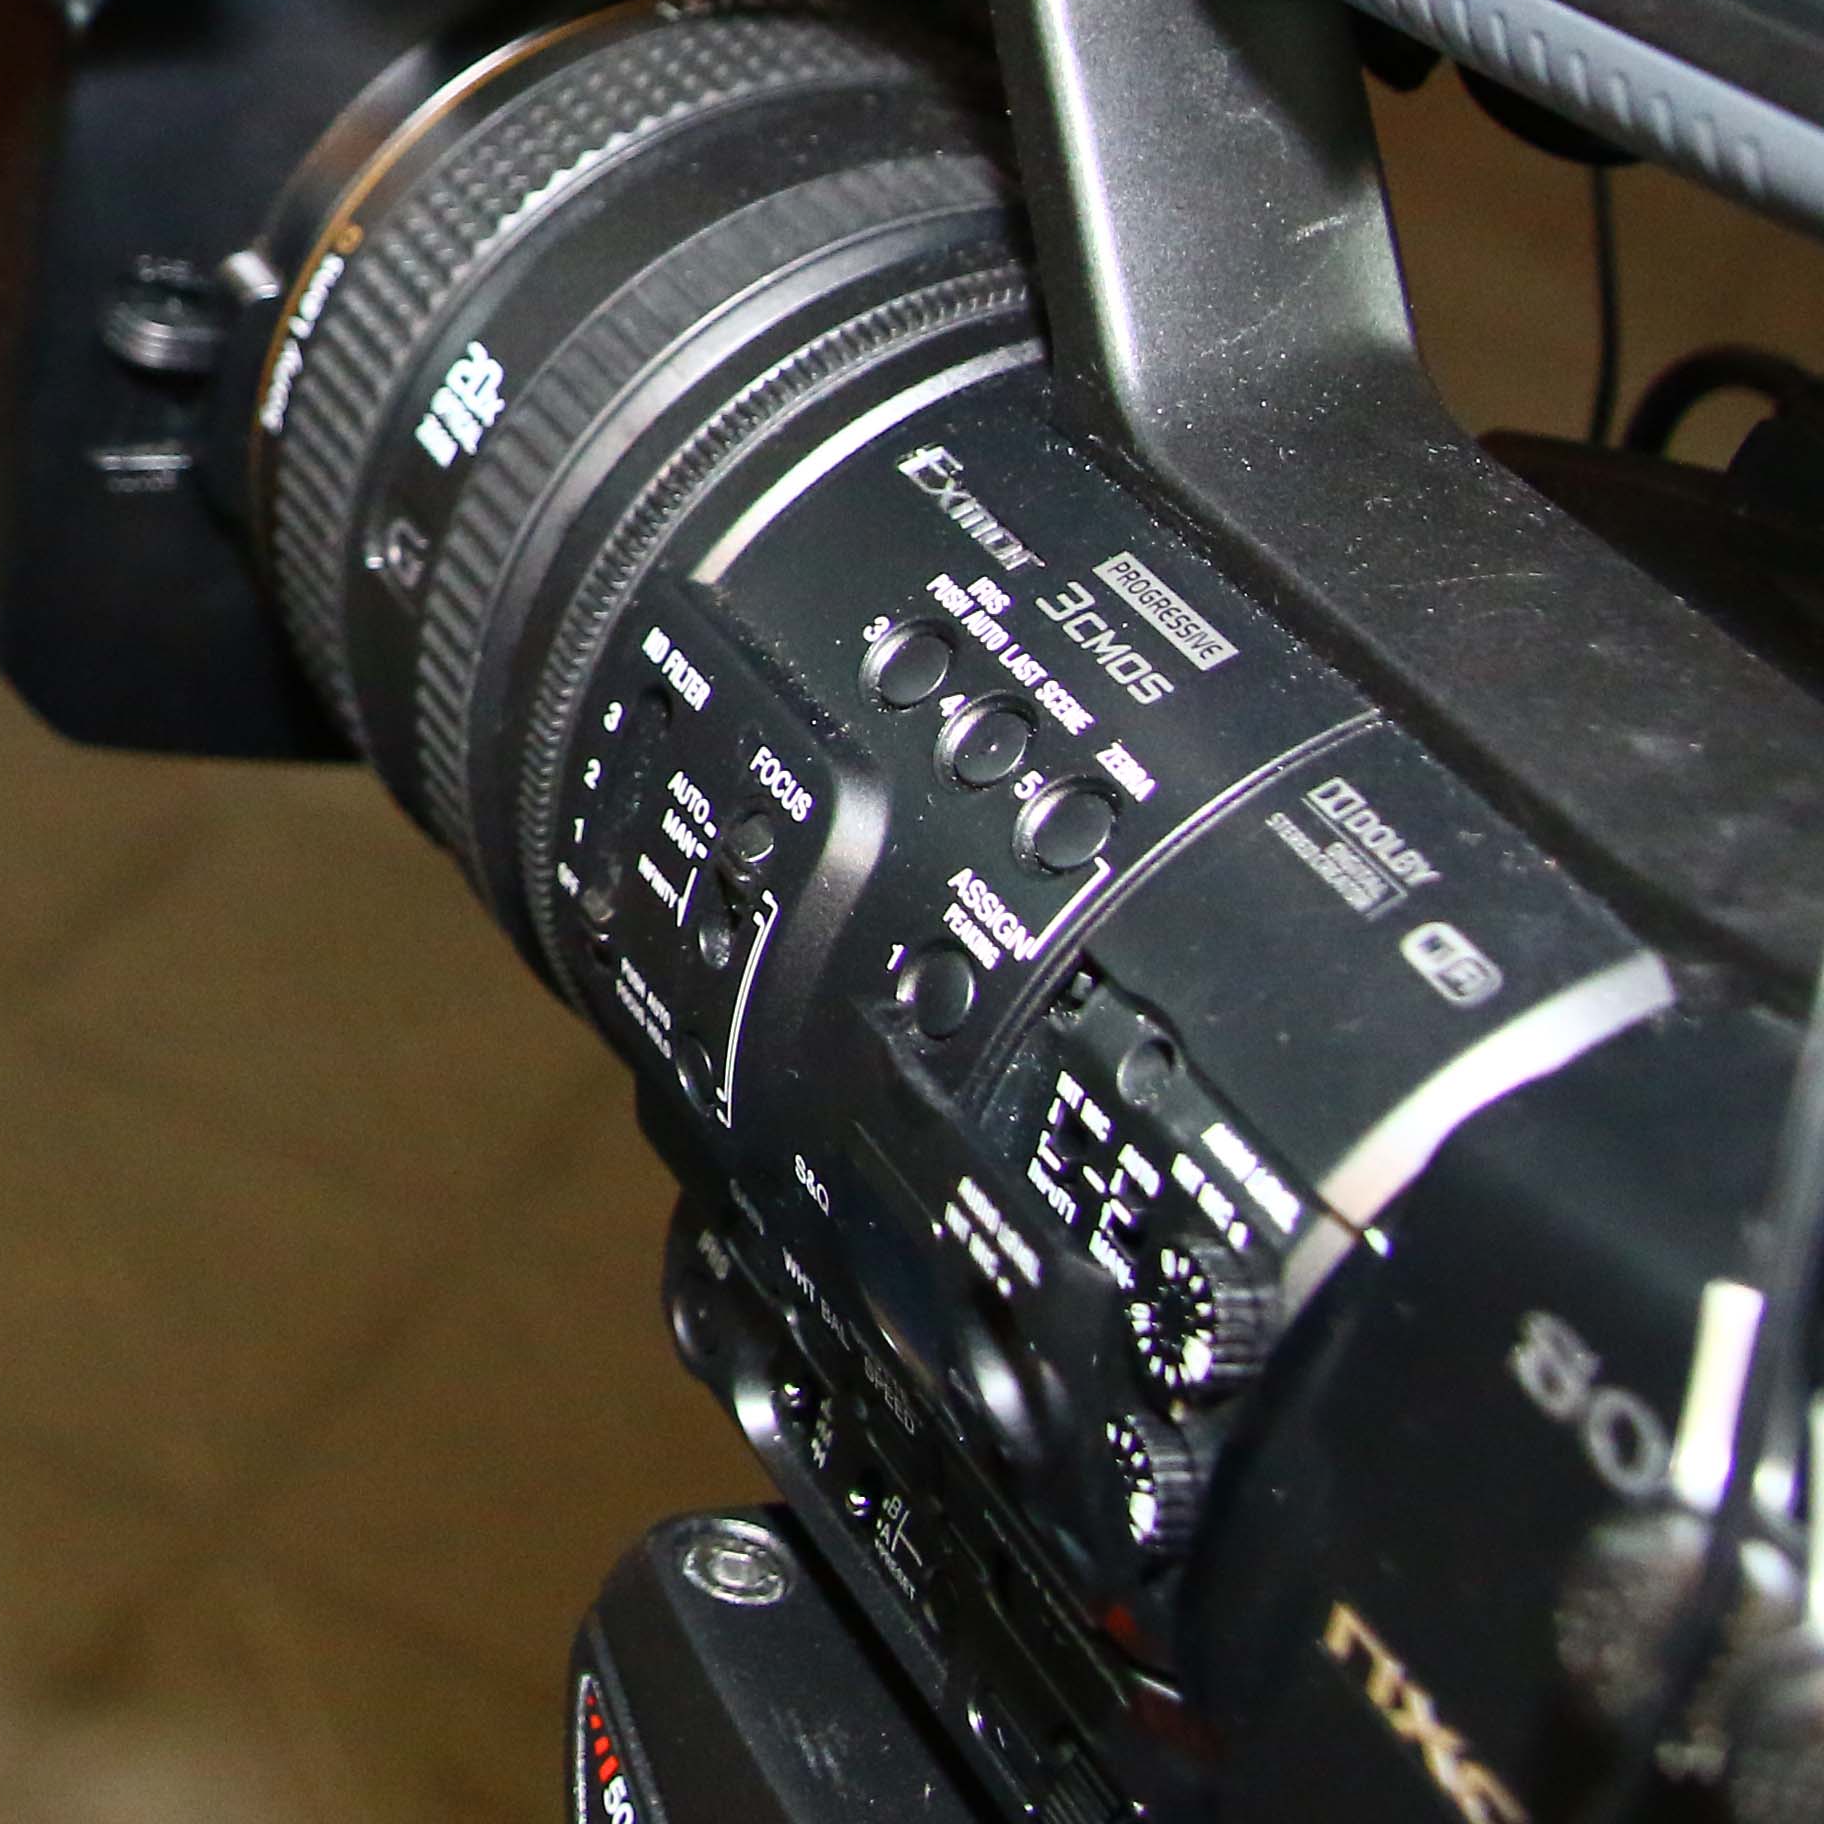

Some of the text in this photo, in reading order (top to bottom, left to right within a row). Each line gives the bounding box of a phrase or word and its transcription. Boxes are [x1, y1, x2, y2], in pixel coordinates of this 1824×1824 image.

[967, 576, 1013, 616] IRIS
[1104, 559, 1226, 663] PROGRESSIVE
[862, 616, 890, 643] 3
[926, 572, 1096, 737] PUSH AUTO LAST SCENE
[1035, 580, 1176, 705] 3CMOS
[603, 700, 624, 733] 3
[583, 757, 601, 791] 2
[667, 770, 712, 825] AUTO
[749, 745, 814, 823] FOCUS
[1013, 770, 1045, 801] 5
[573, 817, 585, 844] 1
[661, 807, 697, 859] MAN
[1343, 806, 1442, 888] DOLBY
[946, 866, 1038, 962] ASSIGN
[885, 943, 905, 971] 1
[794, 1153, 831, 1217] S&Q
